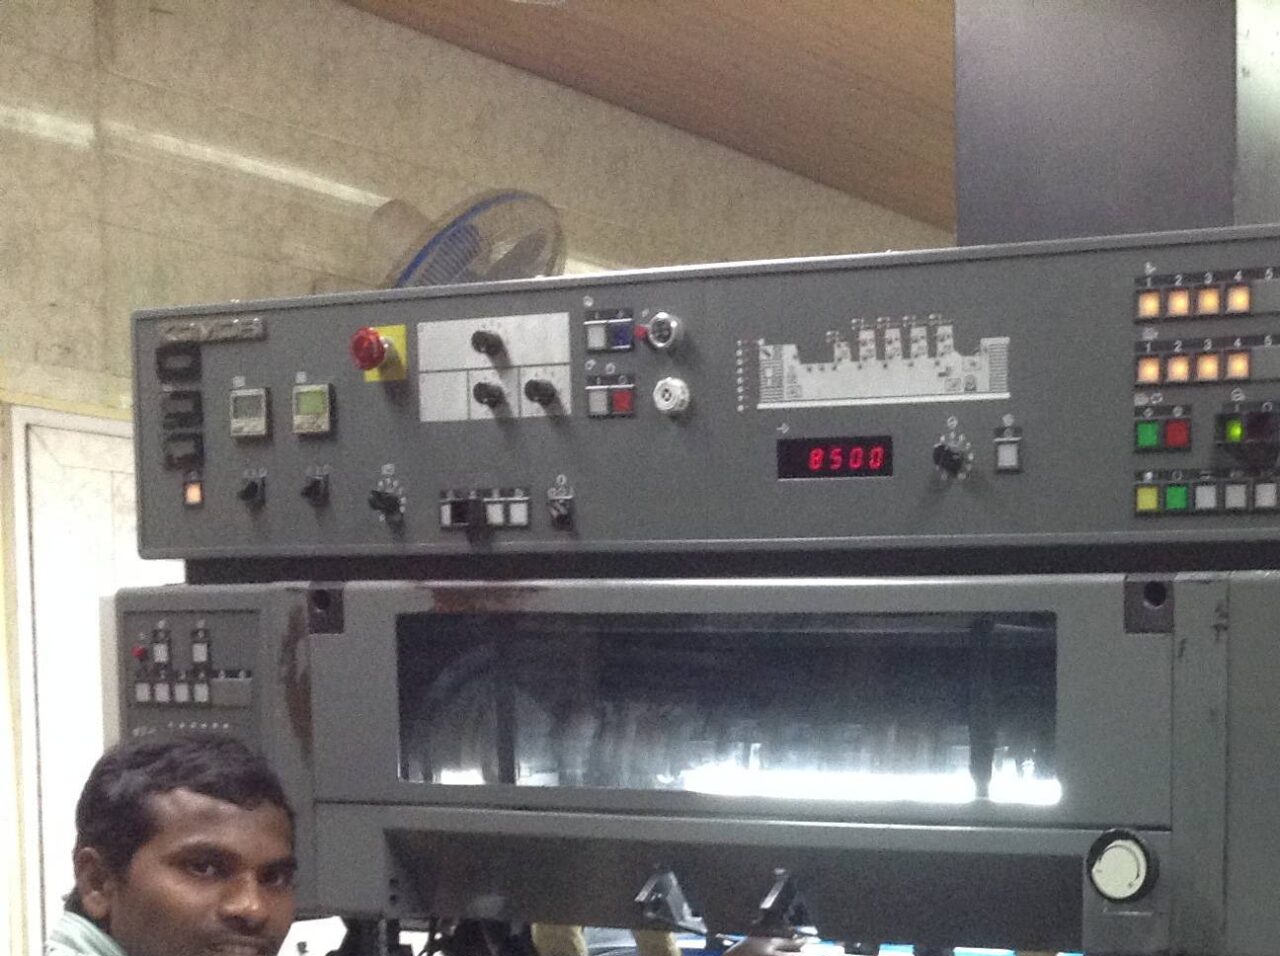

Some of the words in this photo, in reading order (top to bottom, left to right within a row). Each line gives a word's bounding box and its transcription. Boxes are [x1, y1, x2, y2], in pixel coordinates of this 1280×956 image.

[1174, 273, 1184, 287] 2
[1203, 271, 1214, 285] 3
[1233, 269, 1243, 283] 4
[1173, 339, 1183, 353] 2
[1203, 337, 1213, 351] 3
[1233, 336, 1243, 349] 4
[808, 446, 885, 471] 8500
